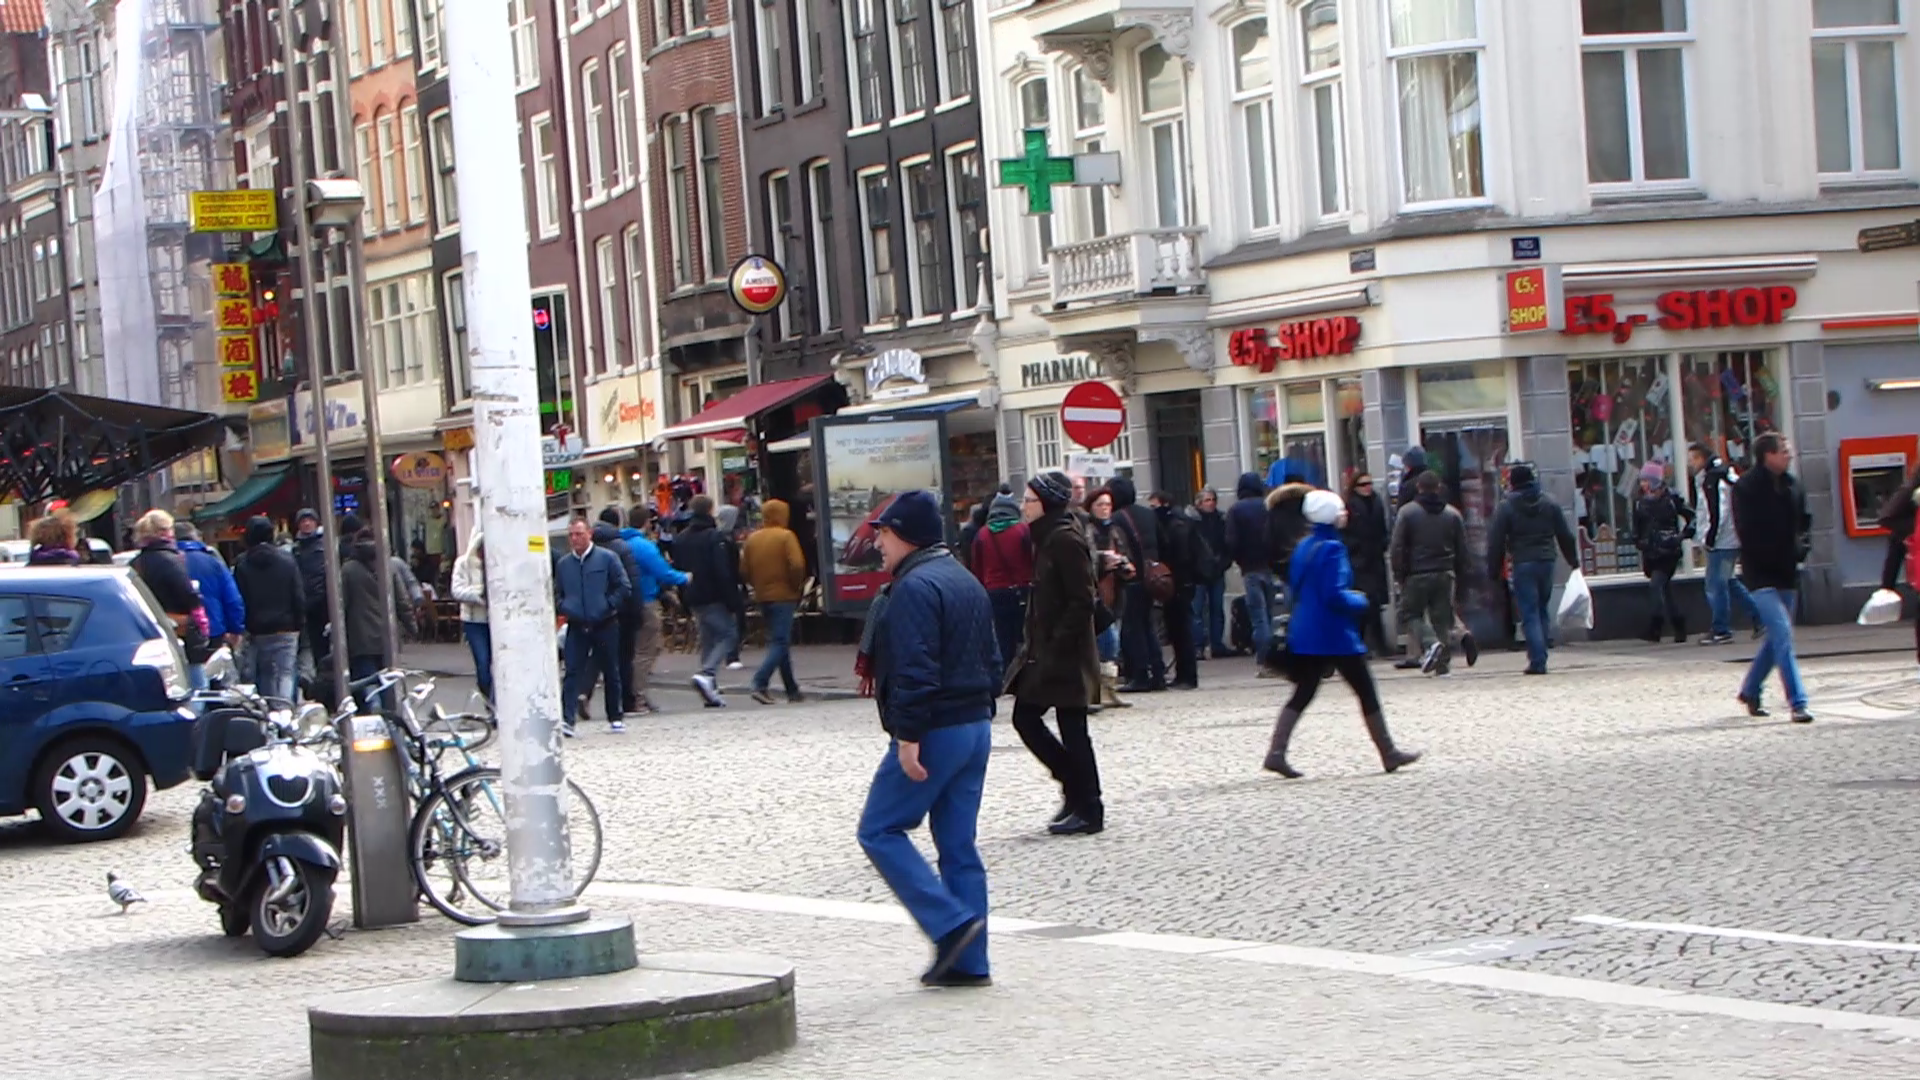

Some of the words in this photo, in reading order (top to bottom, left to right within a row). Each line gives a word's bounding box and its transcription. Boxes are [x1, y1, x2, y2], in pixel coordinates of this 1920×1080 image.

[247, 214, 270, 225] CITY
[1510, 305, 1547, 325] SHOP
[1656, 286, 1797, 330] SHOP
[1278, 316, 1359, 361] SHOP
